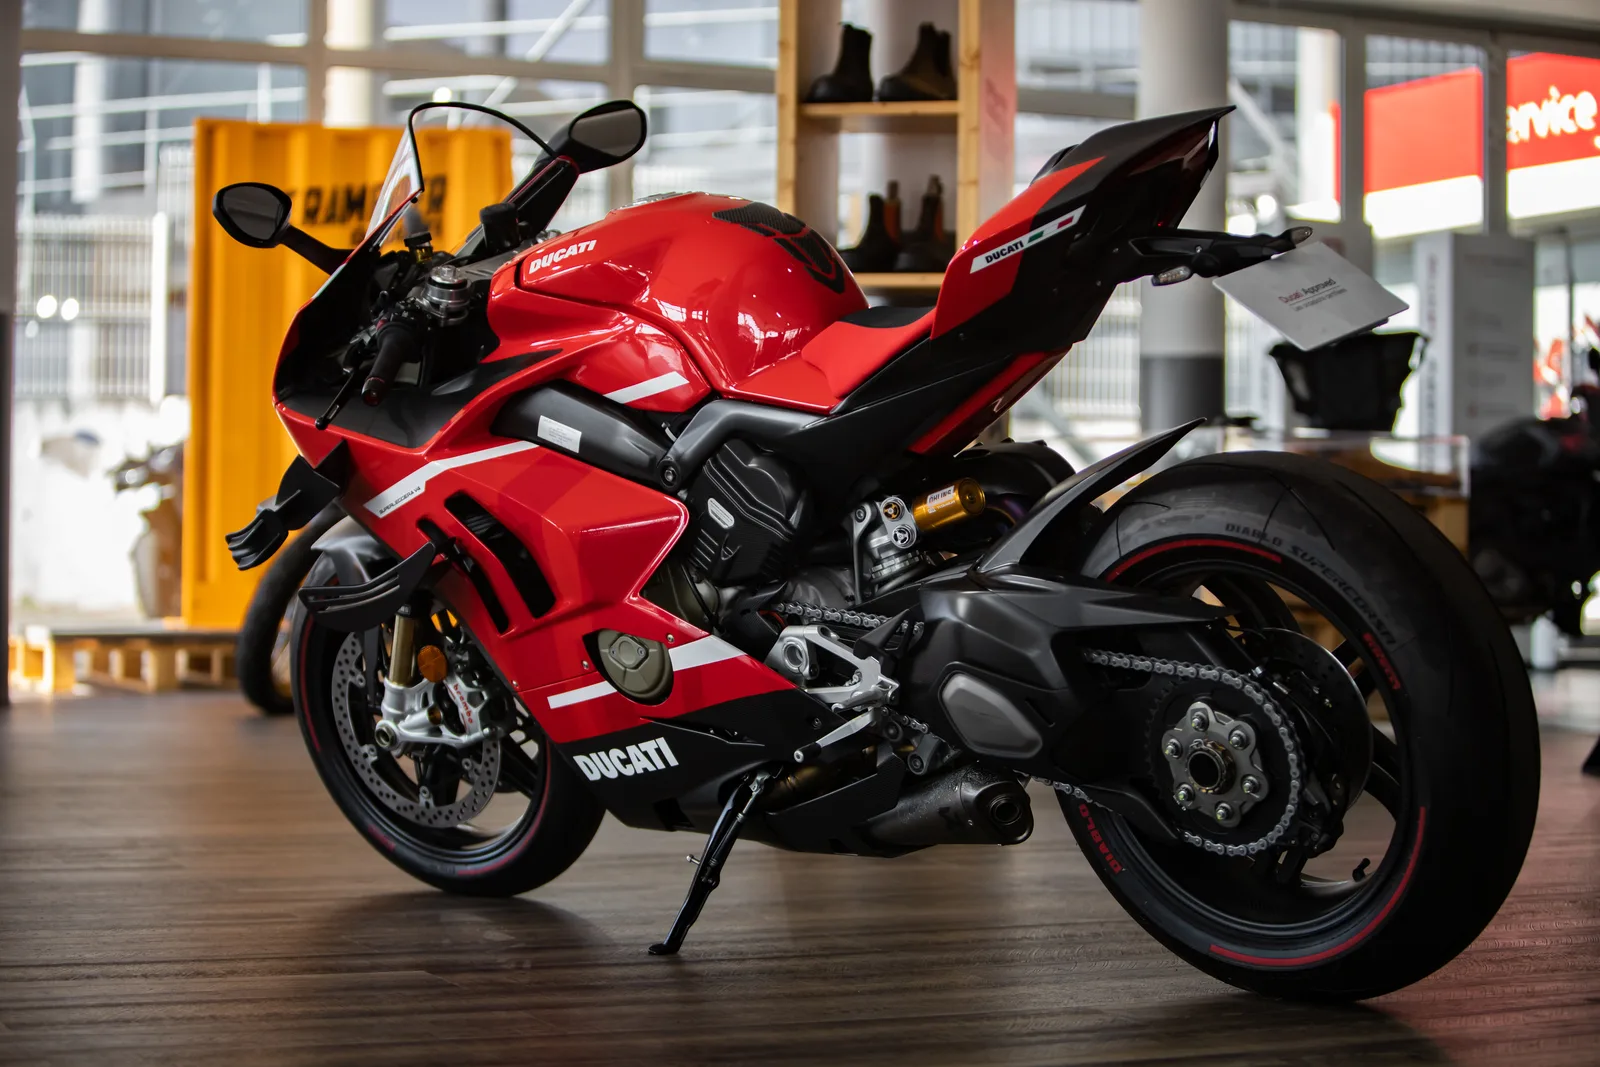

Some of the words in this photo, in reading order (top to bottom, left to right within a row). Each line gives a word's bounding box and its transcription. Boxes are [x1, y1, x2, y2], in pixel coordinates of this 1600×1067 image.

[529, 239, 597, 274] DUCATI
[985, 240, 1024, 263] DUCATI
[1225, 522, 1284, 548] DIABLO
[1290, 544, 1397, 647] SUPERCORSA
[453, 682, 474, 725] brembo
[572, 736, 680, 782] DUCATI
[1079, 803, 1123, 874] DIABLO
